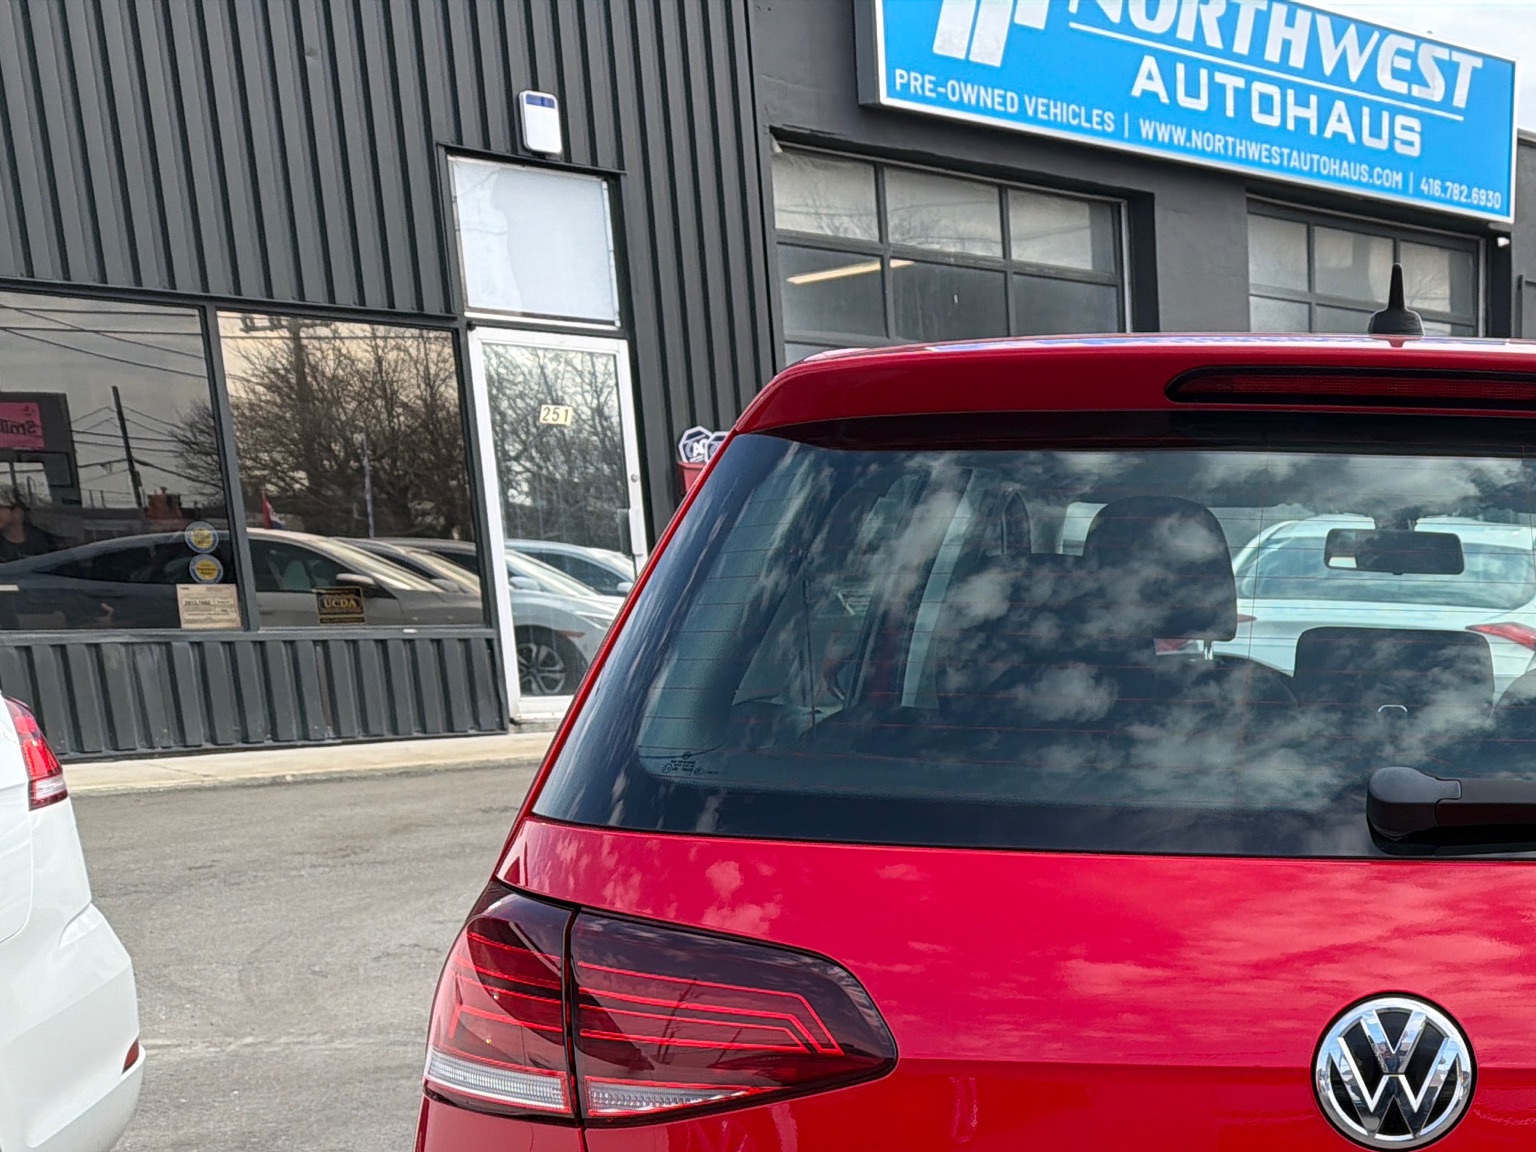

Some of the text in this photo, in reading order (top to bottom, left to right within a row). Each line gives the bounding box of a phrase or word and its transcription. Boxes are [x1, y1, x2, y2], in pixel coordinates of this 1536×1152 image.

[1131, 55, 1422, 157] AUTOHAUS
[895, 68, 1502, 210] PRE-OWNED VEHICLES WWW.NORTHWESTAUTOHAUS.COM 416.782.6930
[542, 406, 569, 422] 251
[323, 598, 358, 608] UCDA
